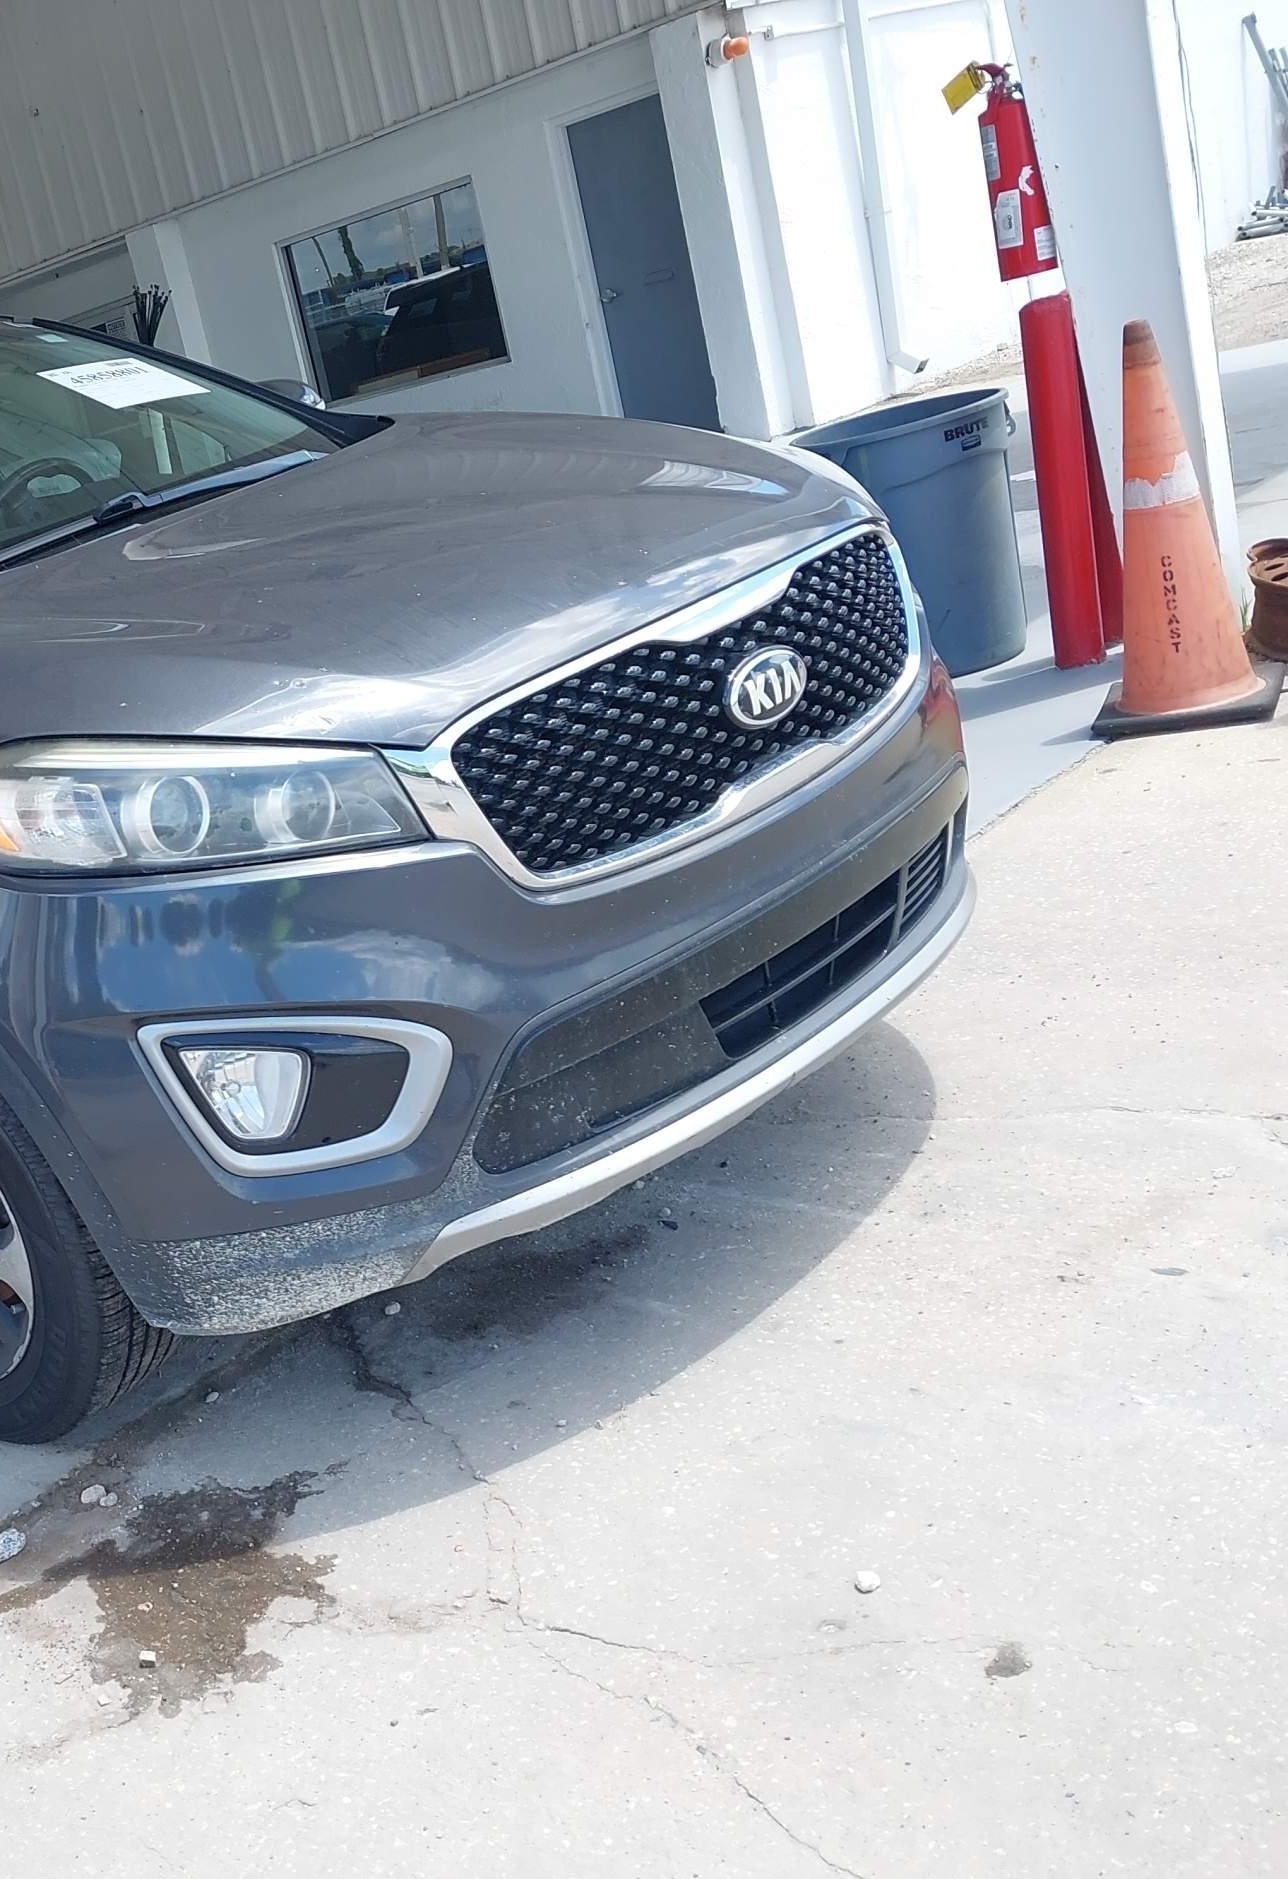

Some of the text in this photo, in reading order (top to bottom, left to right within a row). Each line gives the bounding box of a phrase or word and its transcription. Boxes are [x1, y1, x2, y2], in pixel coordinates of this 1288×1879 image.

[943, 416, 989, 442] BRUTE
[1160, 555, 1181, 653] COMCAST
[743, 660, 801, 716] KIA
